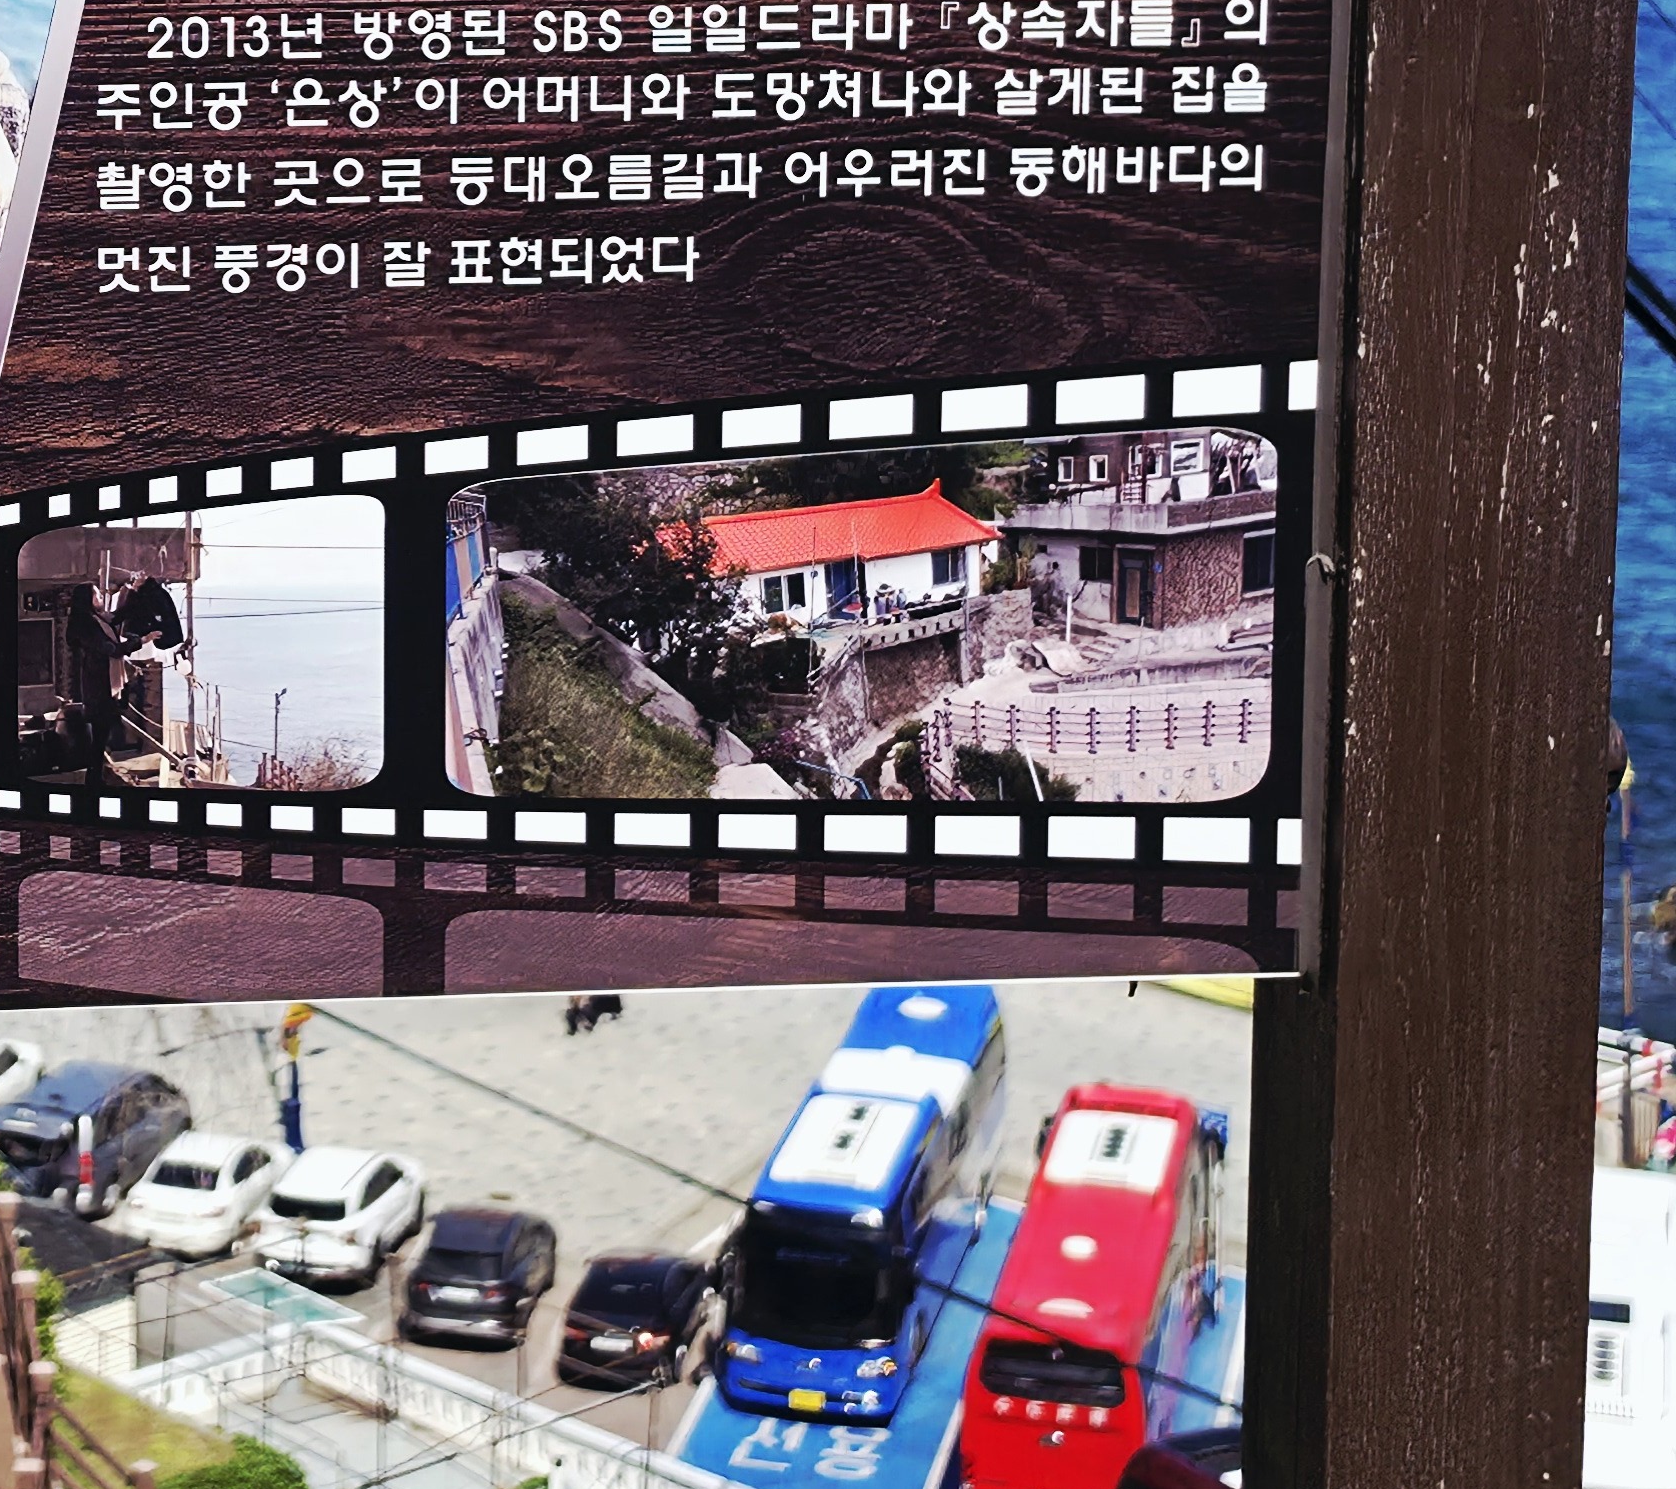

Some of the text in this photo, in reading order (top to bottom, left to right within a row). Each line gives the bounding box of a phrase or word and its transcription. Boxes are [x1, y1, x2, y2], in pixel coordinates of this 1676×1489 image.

[148, 13, 323, 58] 2013년
[354, 10, 505, 59] 방영된
[533, 9, 622, 52] SBS
[649, 3, 913, 52] 일일드라마
[97, 82, 248, 130] 주인공
[483, 73, 691, 122] 어머니와
[712, 69, 972, 120] 도망쳐나와
[995, 67, 1143, 115] 살게된
[1172, 63, 1267, 113] 집을
[97, 144, 1263, 212] 촬영한 곳으로 등대오름길과 어우러진 동해바다의
[98, 236, 699, 293] 멋진 풍경이 잘 표현되었다
